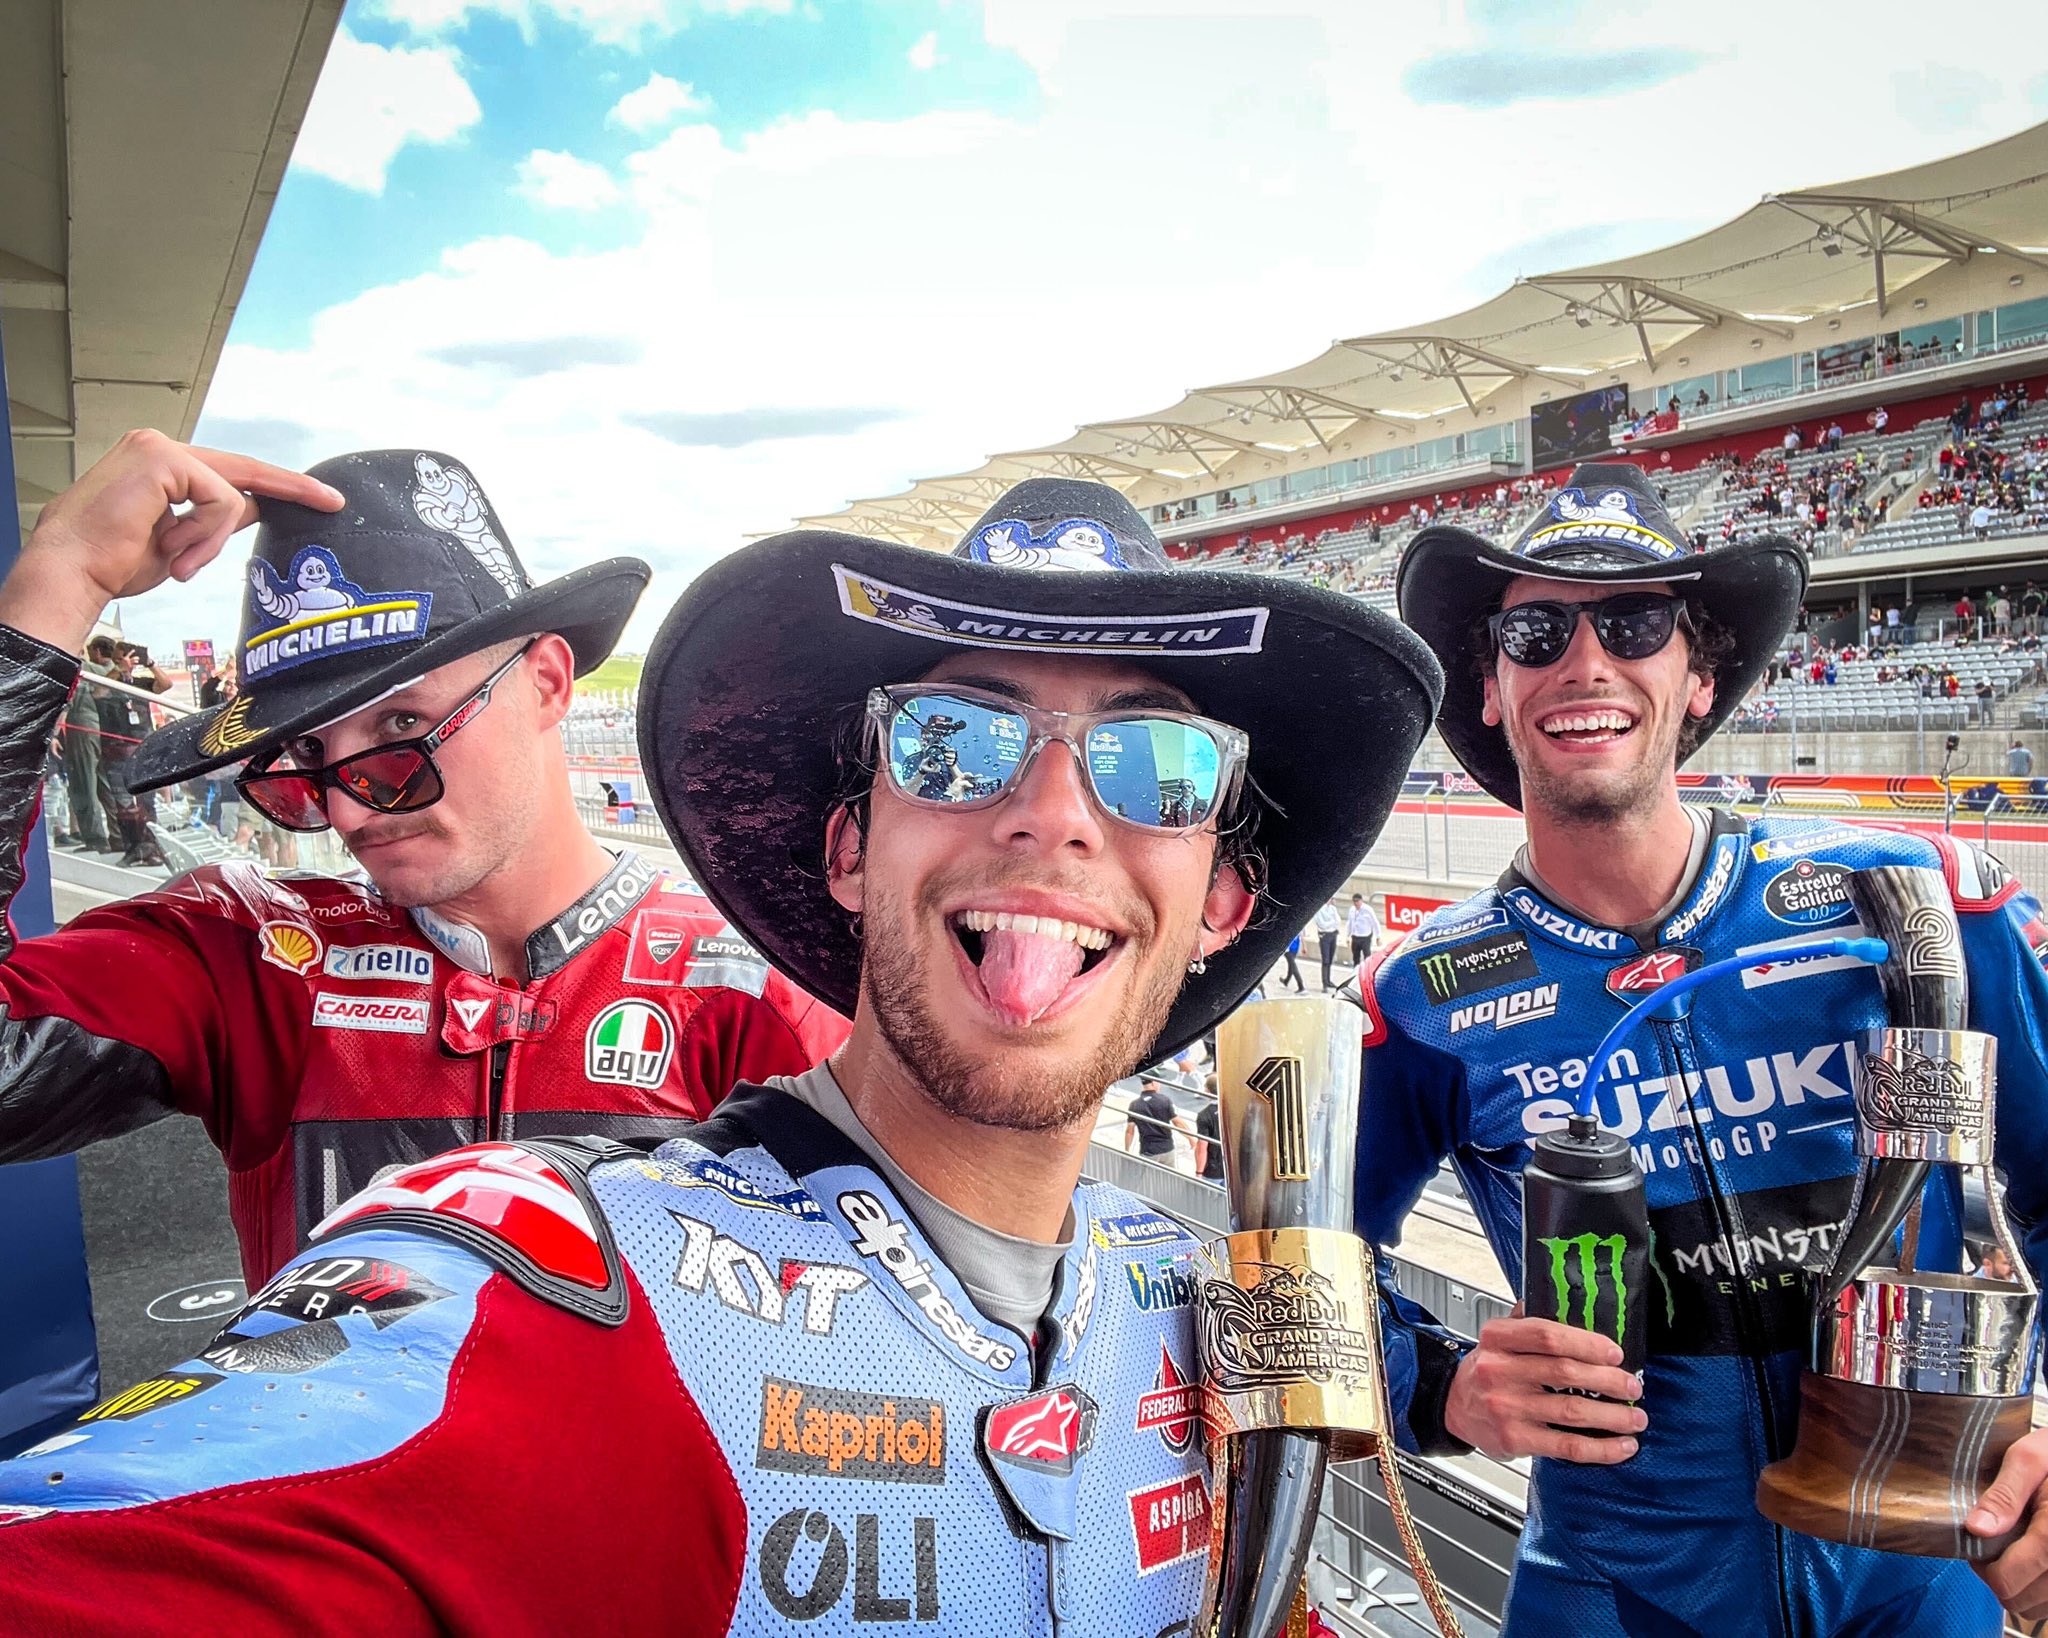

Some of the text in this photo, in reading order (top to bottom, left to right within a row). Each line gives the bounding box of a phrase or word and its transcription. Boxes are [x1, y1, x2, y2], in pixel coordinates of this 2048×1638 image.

[1523, 525, 1675, 558] MICHELIN
[246, 610, 417, 675] MICHELIN
[957, 619, 1221, 644] MICHELIN
[1665, 846, 1734, 941] alpinestars
[1785, 886, 1845, 911] Galicia
[651, 930, 683, 939] DUCATI
[1423, 914, 1495, 940] MICHELIN
[1515, 896, 1617, 950] SUZUKI
[1455, 940, 1528, 969] MONSTER
[1904, 906, 1958, 977] 2
[354, 949, 430, 976] riello
[1470, 955, 1519, 973] ENERGY
[318, 1000, 424, 1022] CARRERA
[1450, 983, 1559, 1034] NOLAN
[597, 1050, 658, 1080] agv
[1902, 1076, 1972, 1095] Red Bull
[1897, 1096, 1983, 1112] GRAND PRIX
[1246, 1057, 1310, 1180] 1
[1911, 1113, 1982, 1127] AMERICAS
[703, 1168, 821, 1215] MICIN
[1124, 1221, 1180, 1238] MICHELIN
[1672, 1219, 1846, 1277] MONST
[661, 1206, 872, 1338] KYT
[1255, 1298, 1348, 1324] Red Bull
[1251, 1330, 1366, 1350] GRAND PRIX
[1273, 1353, 1368, 1372] AMERICAS
[1140, 1392, 1187, 1423] FEDERAL
[763, 1383, 943, 1473] Kapriol
